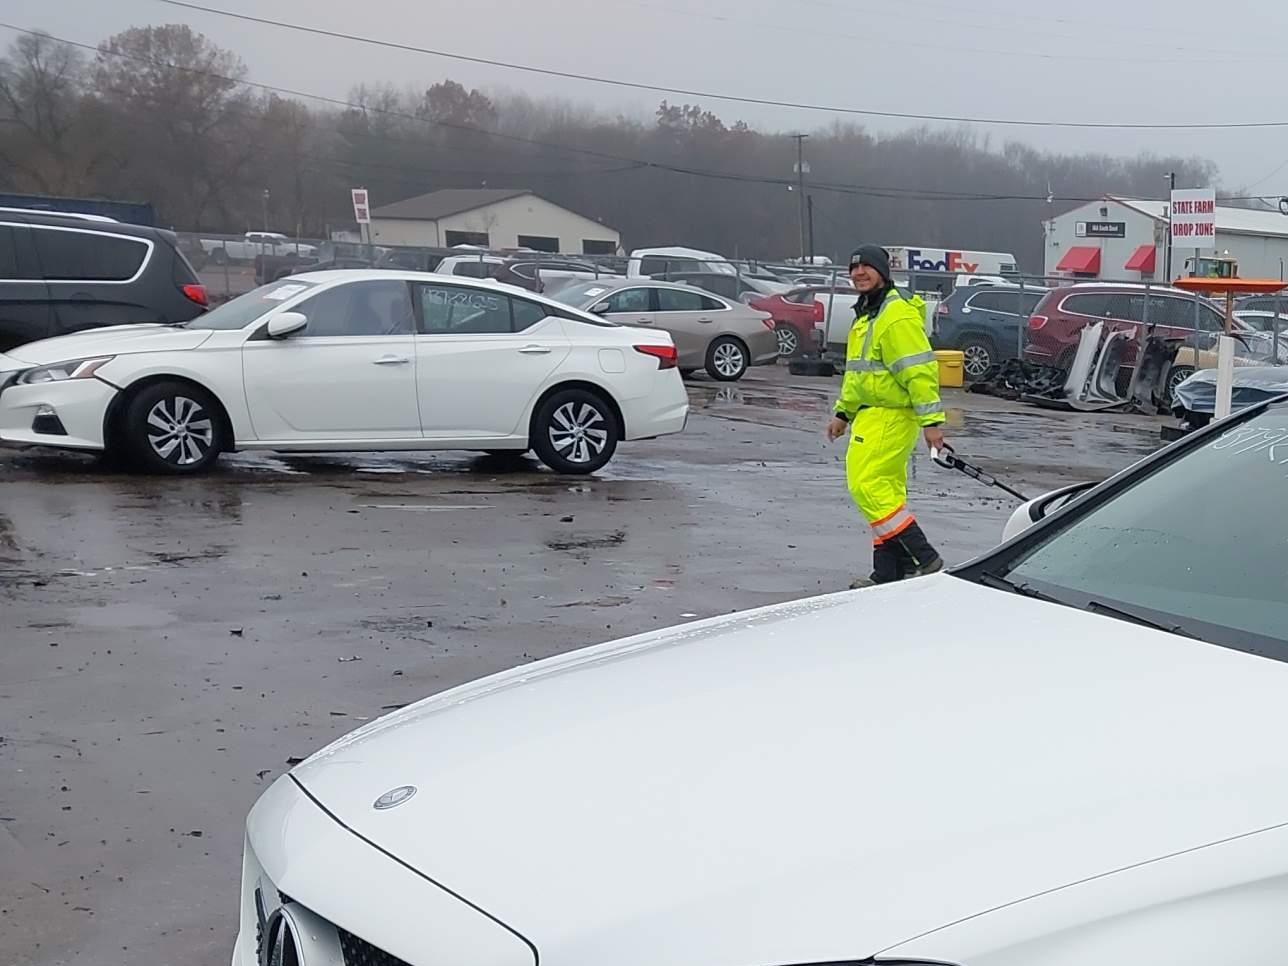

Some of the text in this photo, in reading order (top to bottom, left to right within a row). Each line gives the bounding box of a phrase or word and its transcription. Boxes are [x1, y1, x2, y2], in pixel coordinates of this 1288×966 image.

[1172, 200, 1214, 214] STATE FARM
[1173, 223, 1214, 236] DROP ZONE
[907, 250, 979, 273] FedEx
